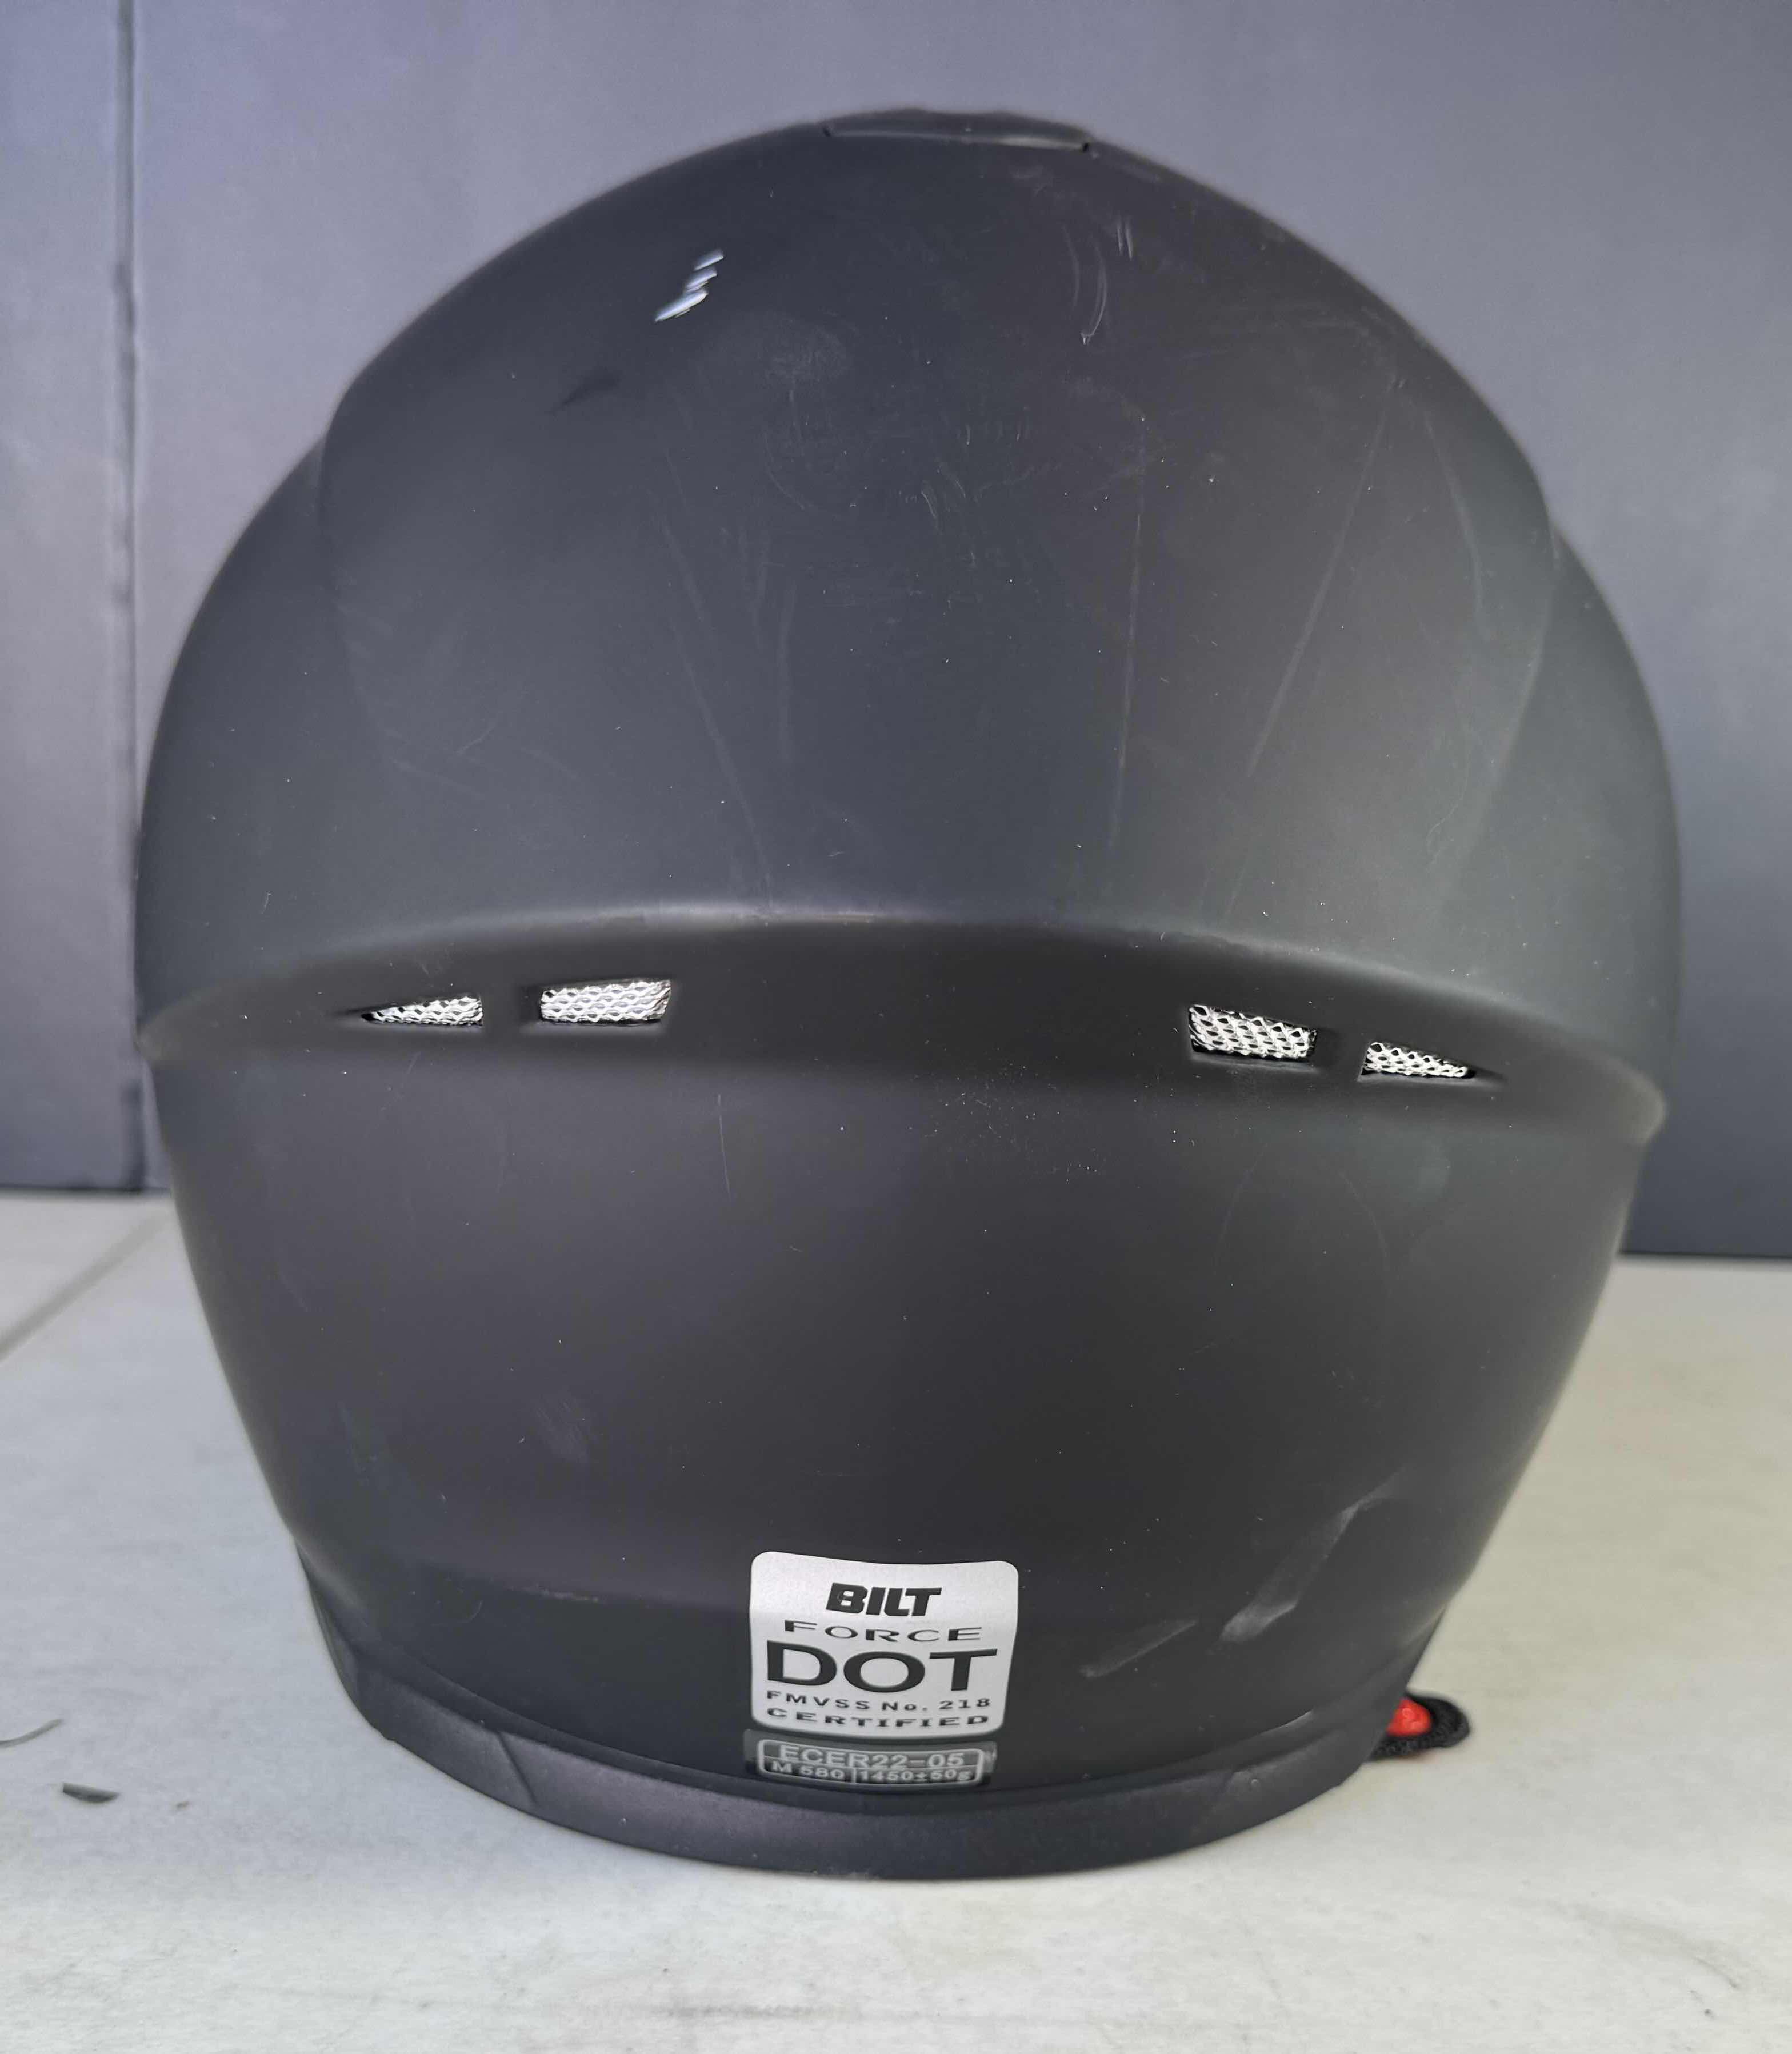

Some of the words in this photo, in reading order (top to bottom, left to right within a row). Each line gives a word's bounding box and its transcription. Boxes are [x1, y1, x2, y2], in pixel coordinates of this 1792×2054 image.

[826, 1583, 942, 1616] BILT
[785, 1620, 982, 1642] FORCE
[767, 1640, 998, 1693] DOT
[767, 1691, 870, 1710] FMVSS
[882, 1701, 927, 1711] No.
[939, 1699, 991, 1710] 218
[767, 1708, 989, 1727] CERTIFIED
[779, 1744, 965, 1769] ECER22-05
[771, 1761, 792, 1773] M
[800, 1765, 845, 1780] 580
